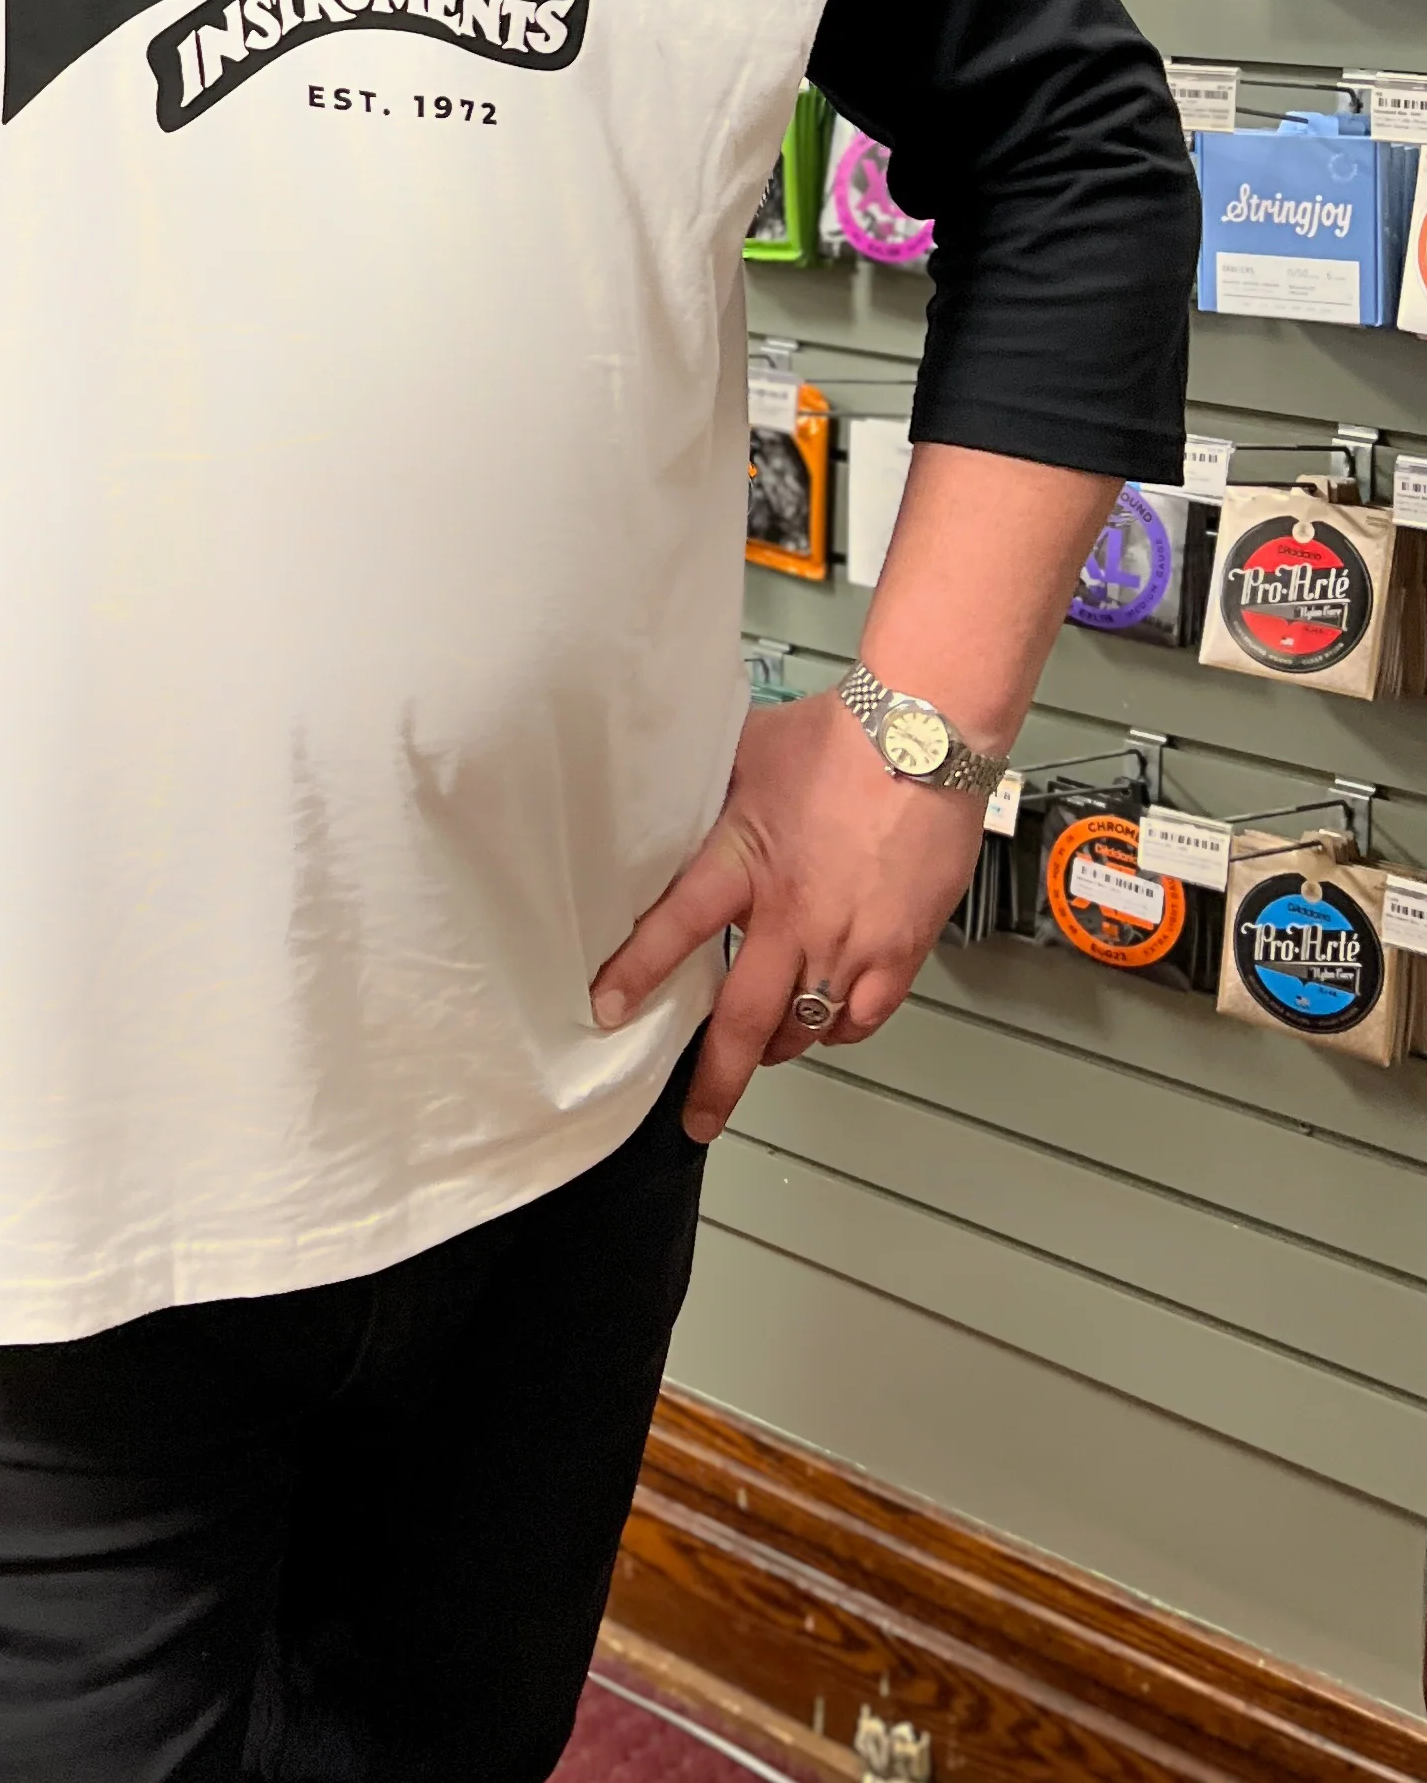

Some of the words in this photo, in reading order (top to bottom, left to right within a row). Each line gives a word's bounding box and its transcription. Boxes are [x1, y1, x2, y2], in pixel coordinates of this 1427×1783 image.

[308, 84, 391, 116] EST.
[414, 94, 499, 125] 1972
[1221, 183, 1353, 238] Stringjoy
[1119, 492, 1153, 523] OUND
[1125, 584, 1158, 617] MEDIUM
[1155, 538, 1166, 578] GAUGE
